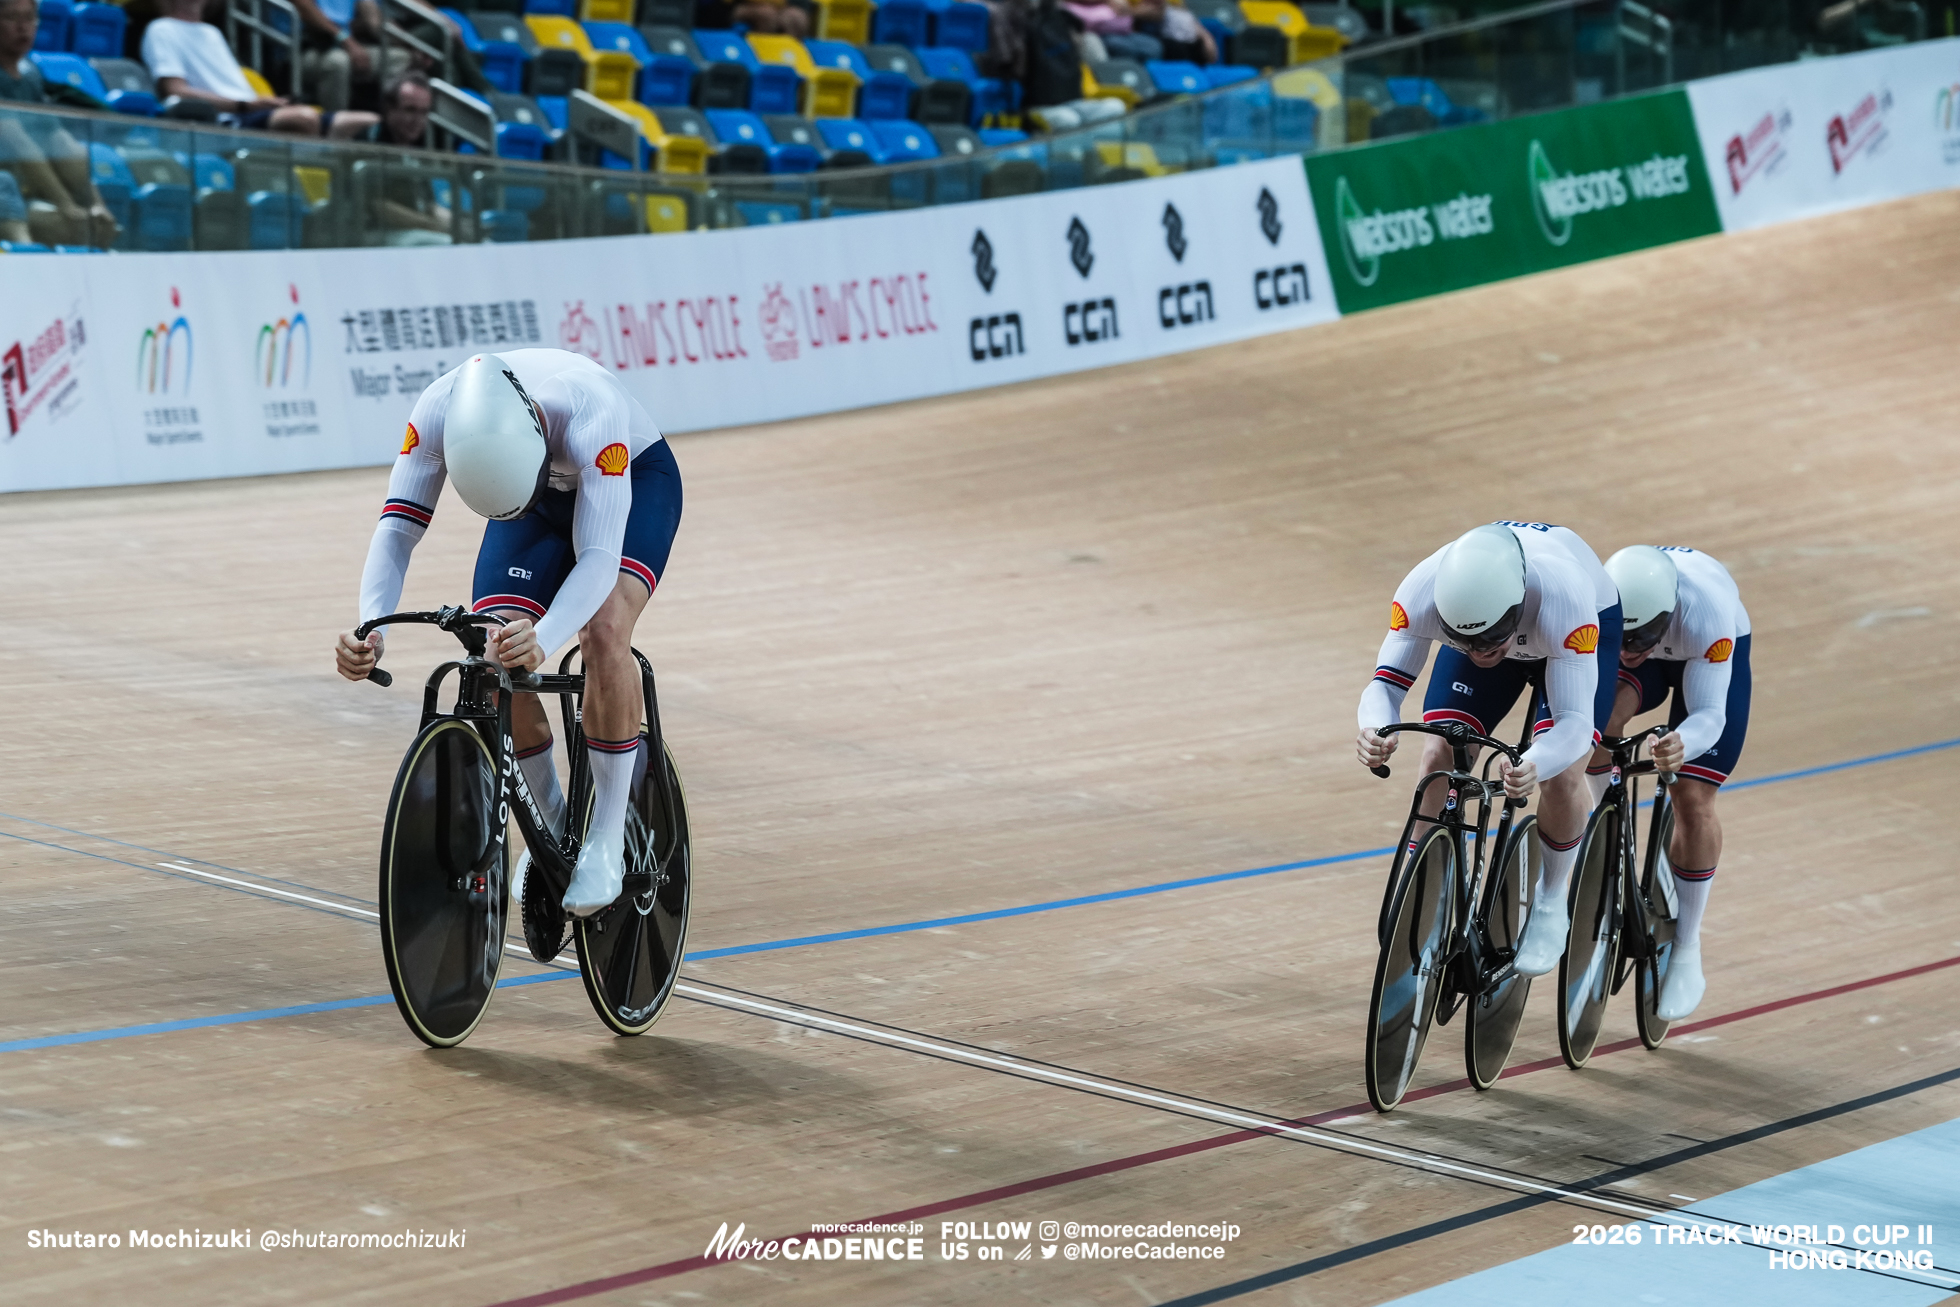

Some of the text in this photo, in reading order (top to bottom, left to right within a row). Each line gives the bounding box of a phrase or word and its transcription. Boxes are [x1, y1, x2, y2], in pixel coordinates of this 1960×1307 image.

[1626, 153, 1689, 200] water
[1432, 191, 1493, 240] water
[677, 294, 748, 361] CYCLE
[869, 271, 937, 338] CYCLE
[1456, 620, 1488, 630] LAZER
[495, 733, 514, 845] LOTUS
